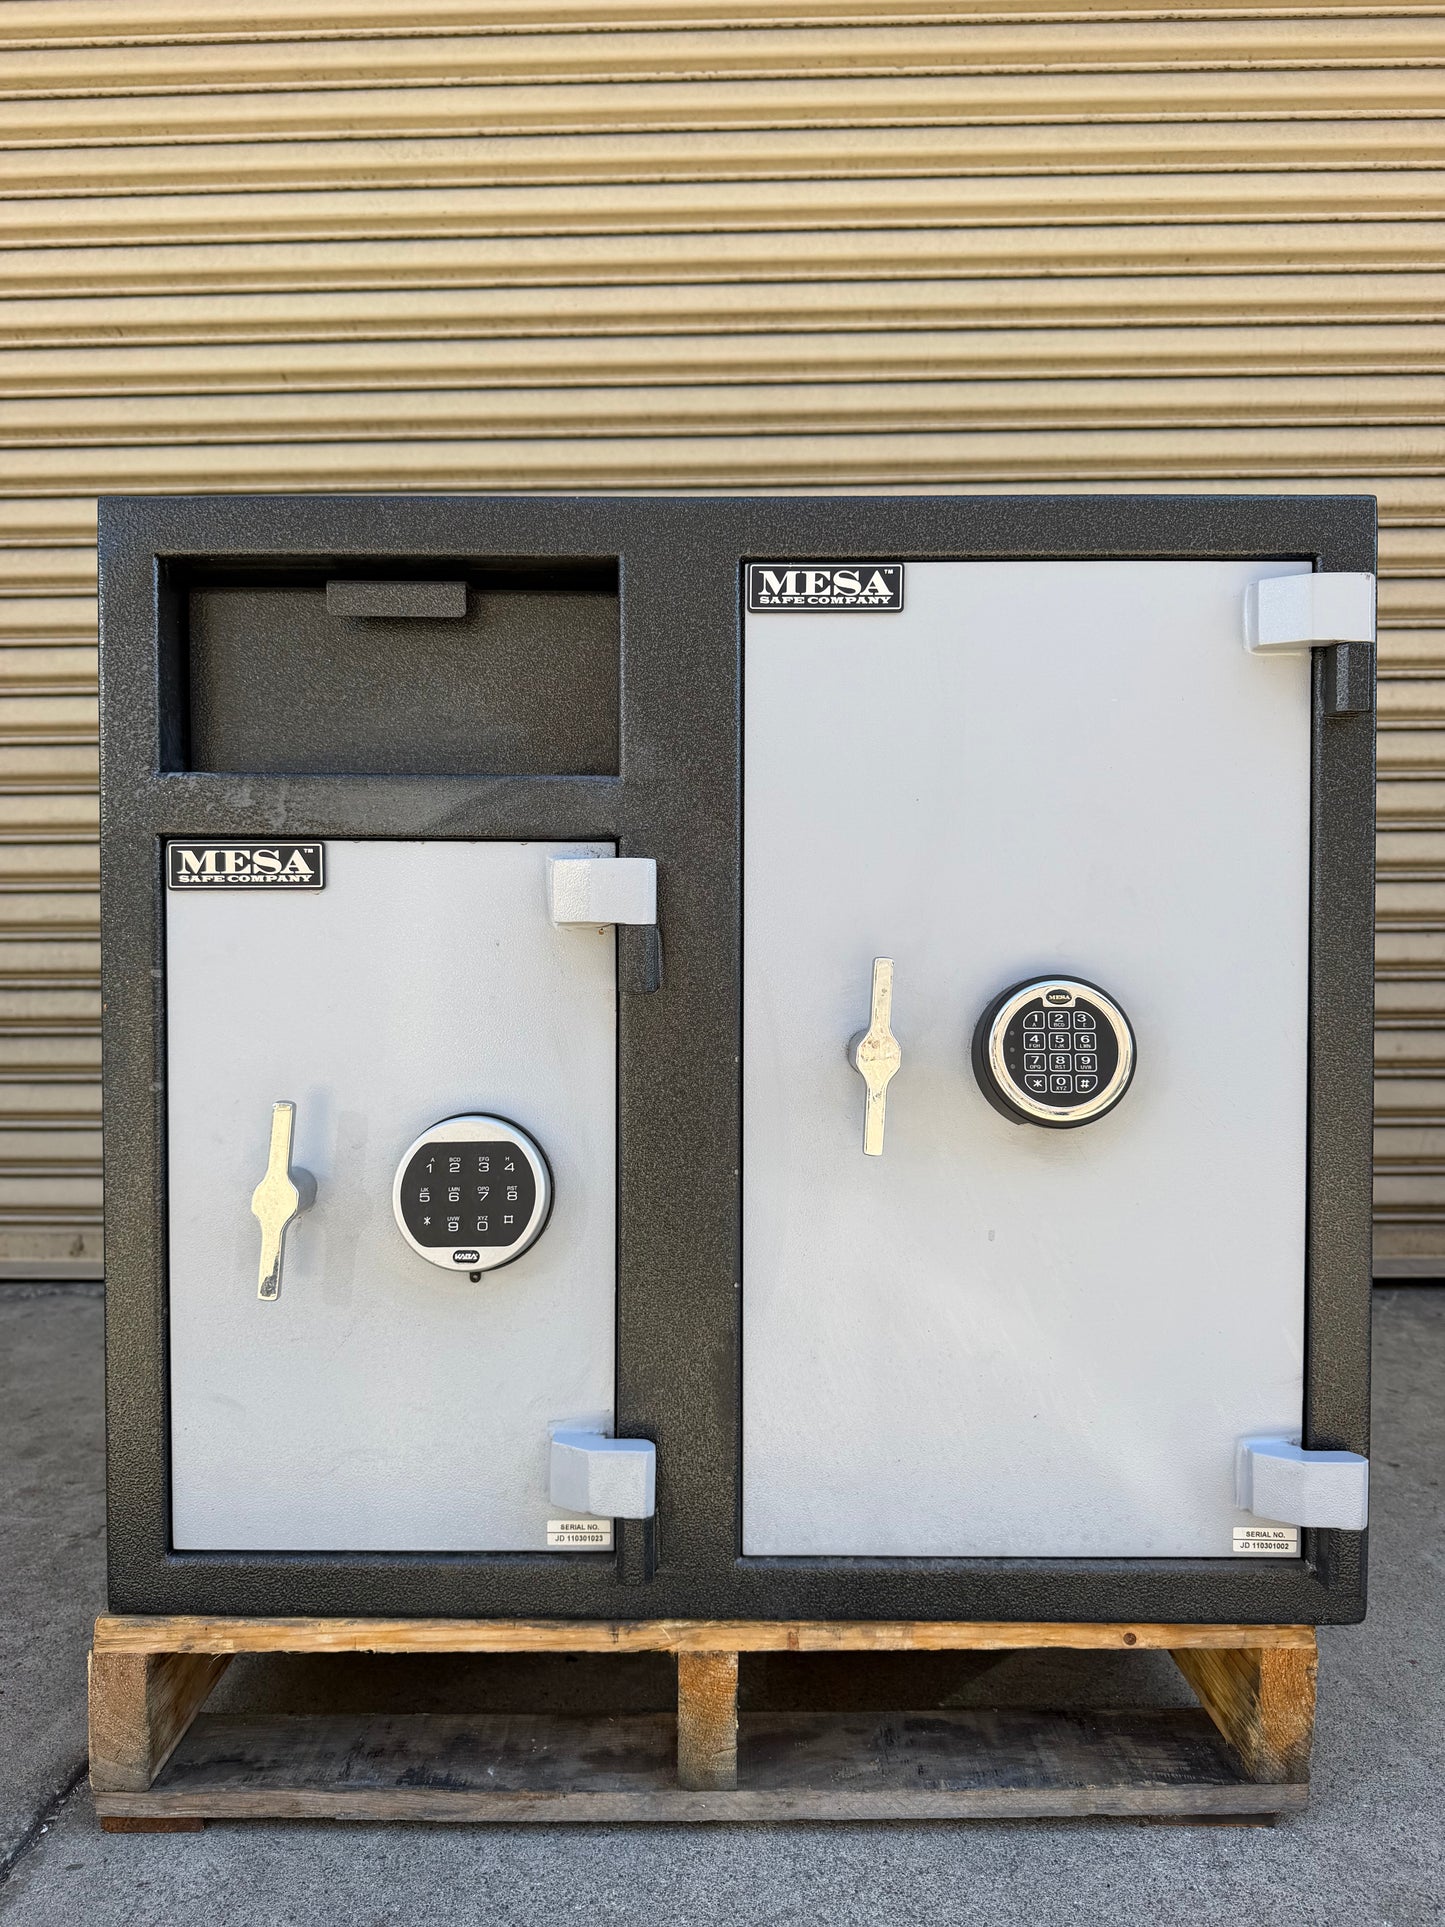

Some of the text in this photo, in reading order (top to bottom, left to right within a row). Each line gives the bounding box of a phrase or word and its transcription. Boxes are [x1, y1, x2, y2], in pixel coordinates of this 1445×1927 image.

[758, 570, 894, 596] MESA
[808, 596, 892, 604] COMPANY
[176, 850, 314, 874] MESA
[1032, 1014, 1038, 1022] 1
[1054, 1014, 1064, 1022] 2
[1077, 1014, 1086, 1022] 3
[1030, 1035, 1039, 1043] 4
[1055, 1035, 1064, 1043] 5
[1080, 1035, 1090, 1043] 6
[1031, 1056, 1039, 1064] 7
[1056, 1056, 1065, 1064] 8
[1081, 1056, 1090, 1064] 9
[426, 1164, 432, 1174] 1
[450, 1163, 460, 1173] 2
[479, 1162, 490, 1172] 3
[504, 1162, 515, 1172] 4
[420, 1193, 430, 1202] 5
[448, 1192, 460, 1202] 6
[478, 1192, 489, 1201] 7
[507, 1191, 518, 1200] 8
[448, 1222, 458, 1232] 9
